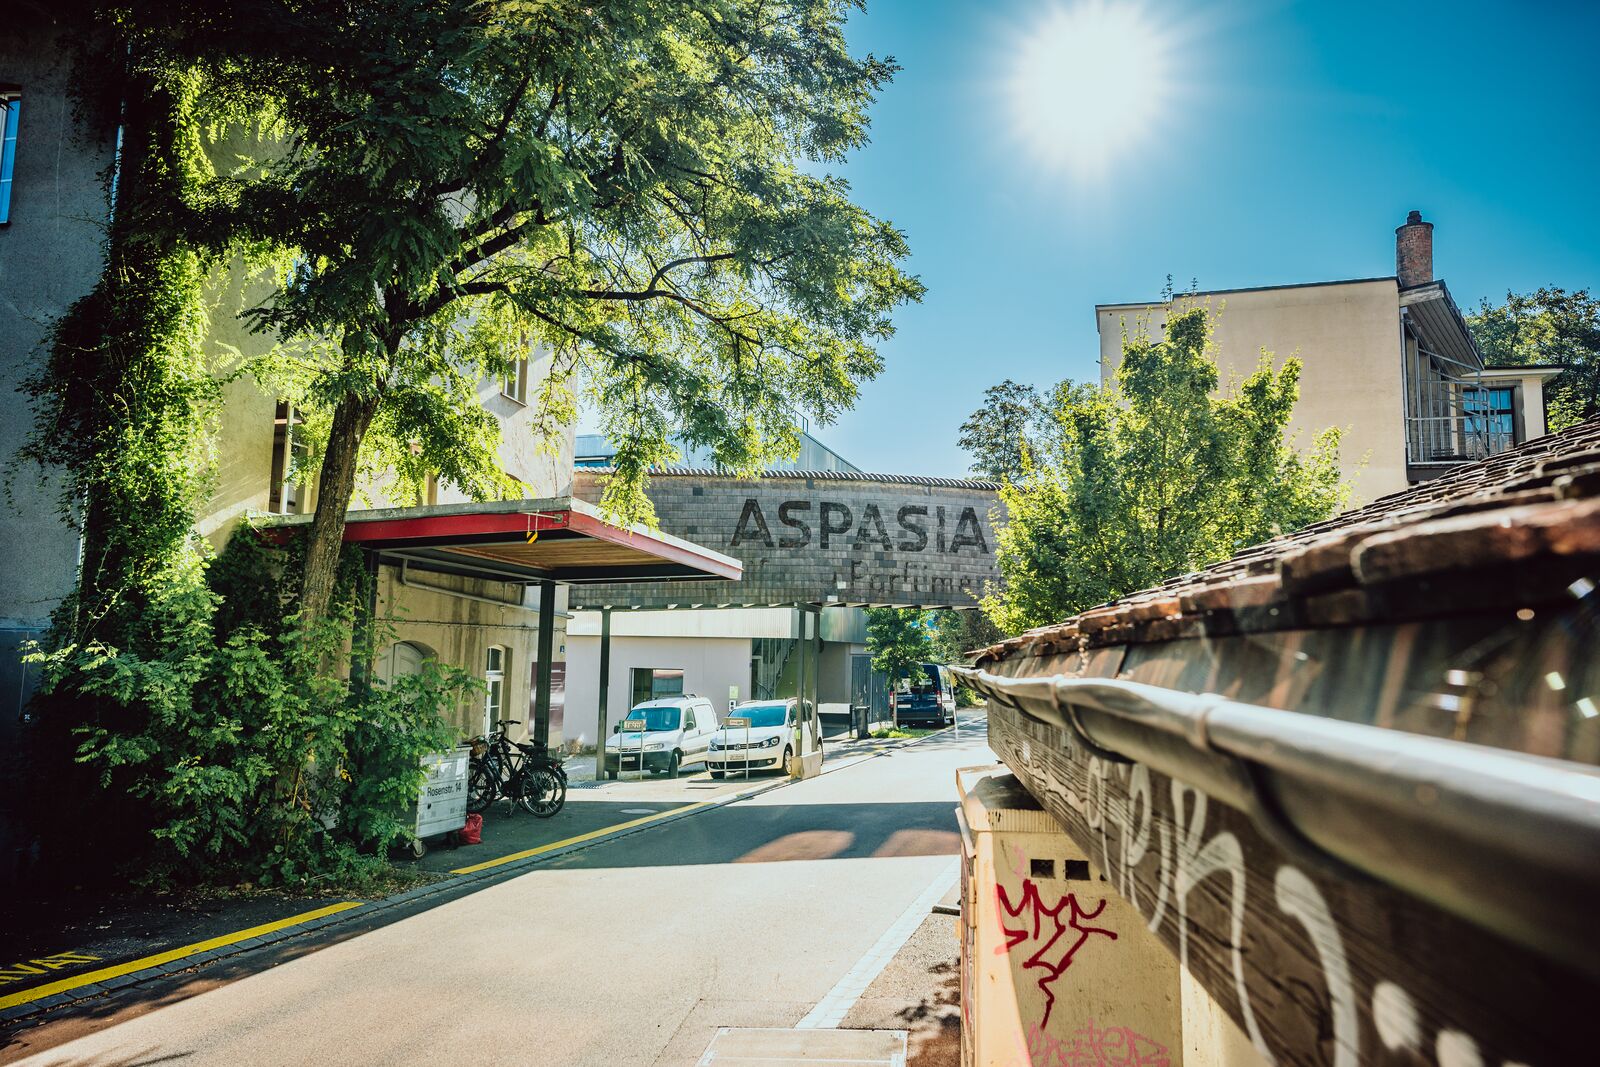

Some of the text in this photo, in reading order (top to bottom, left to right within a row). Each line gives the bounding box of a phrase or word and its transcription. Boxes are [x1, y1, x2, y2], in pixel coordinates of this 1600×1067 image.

[730, 498, 990, 554] ASPASIA
[427, 782, 462, 797] Rosenstr. 14
